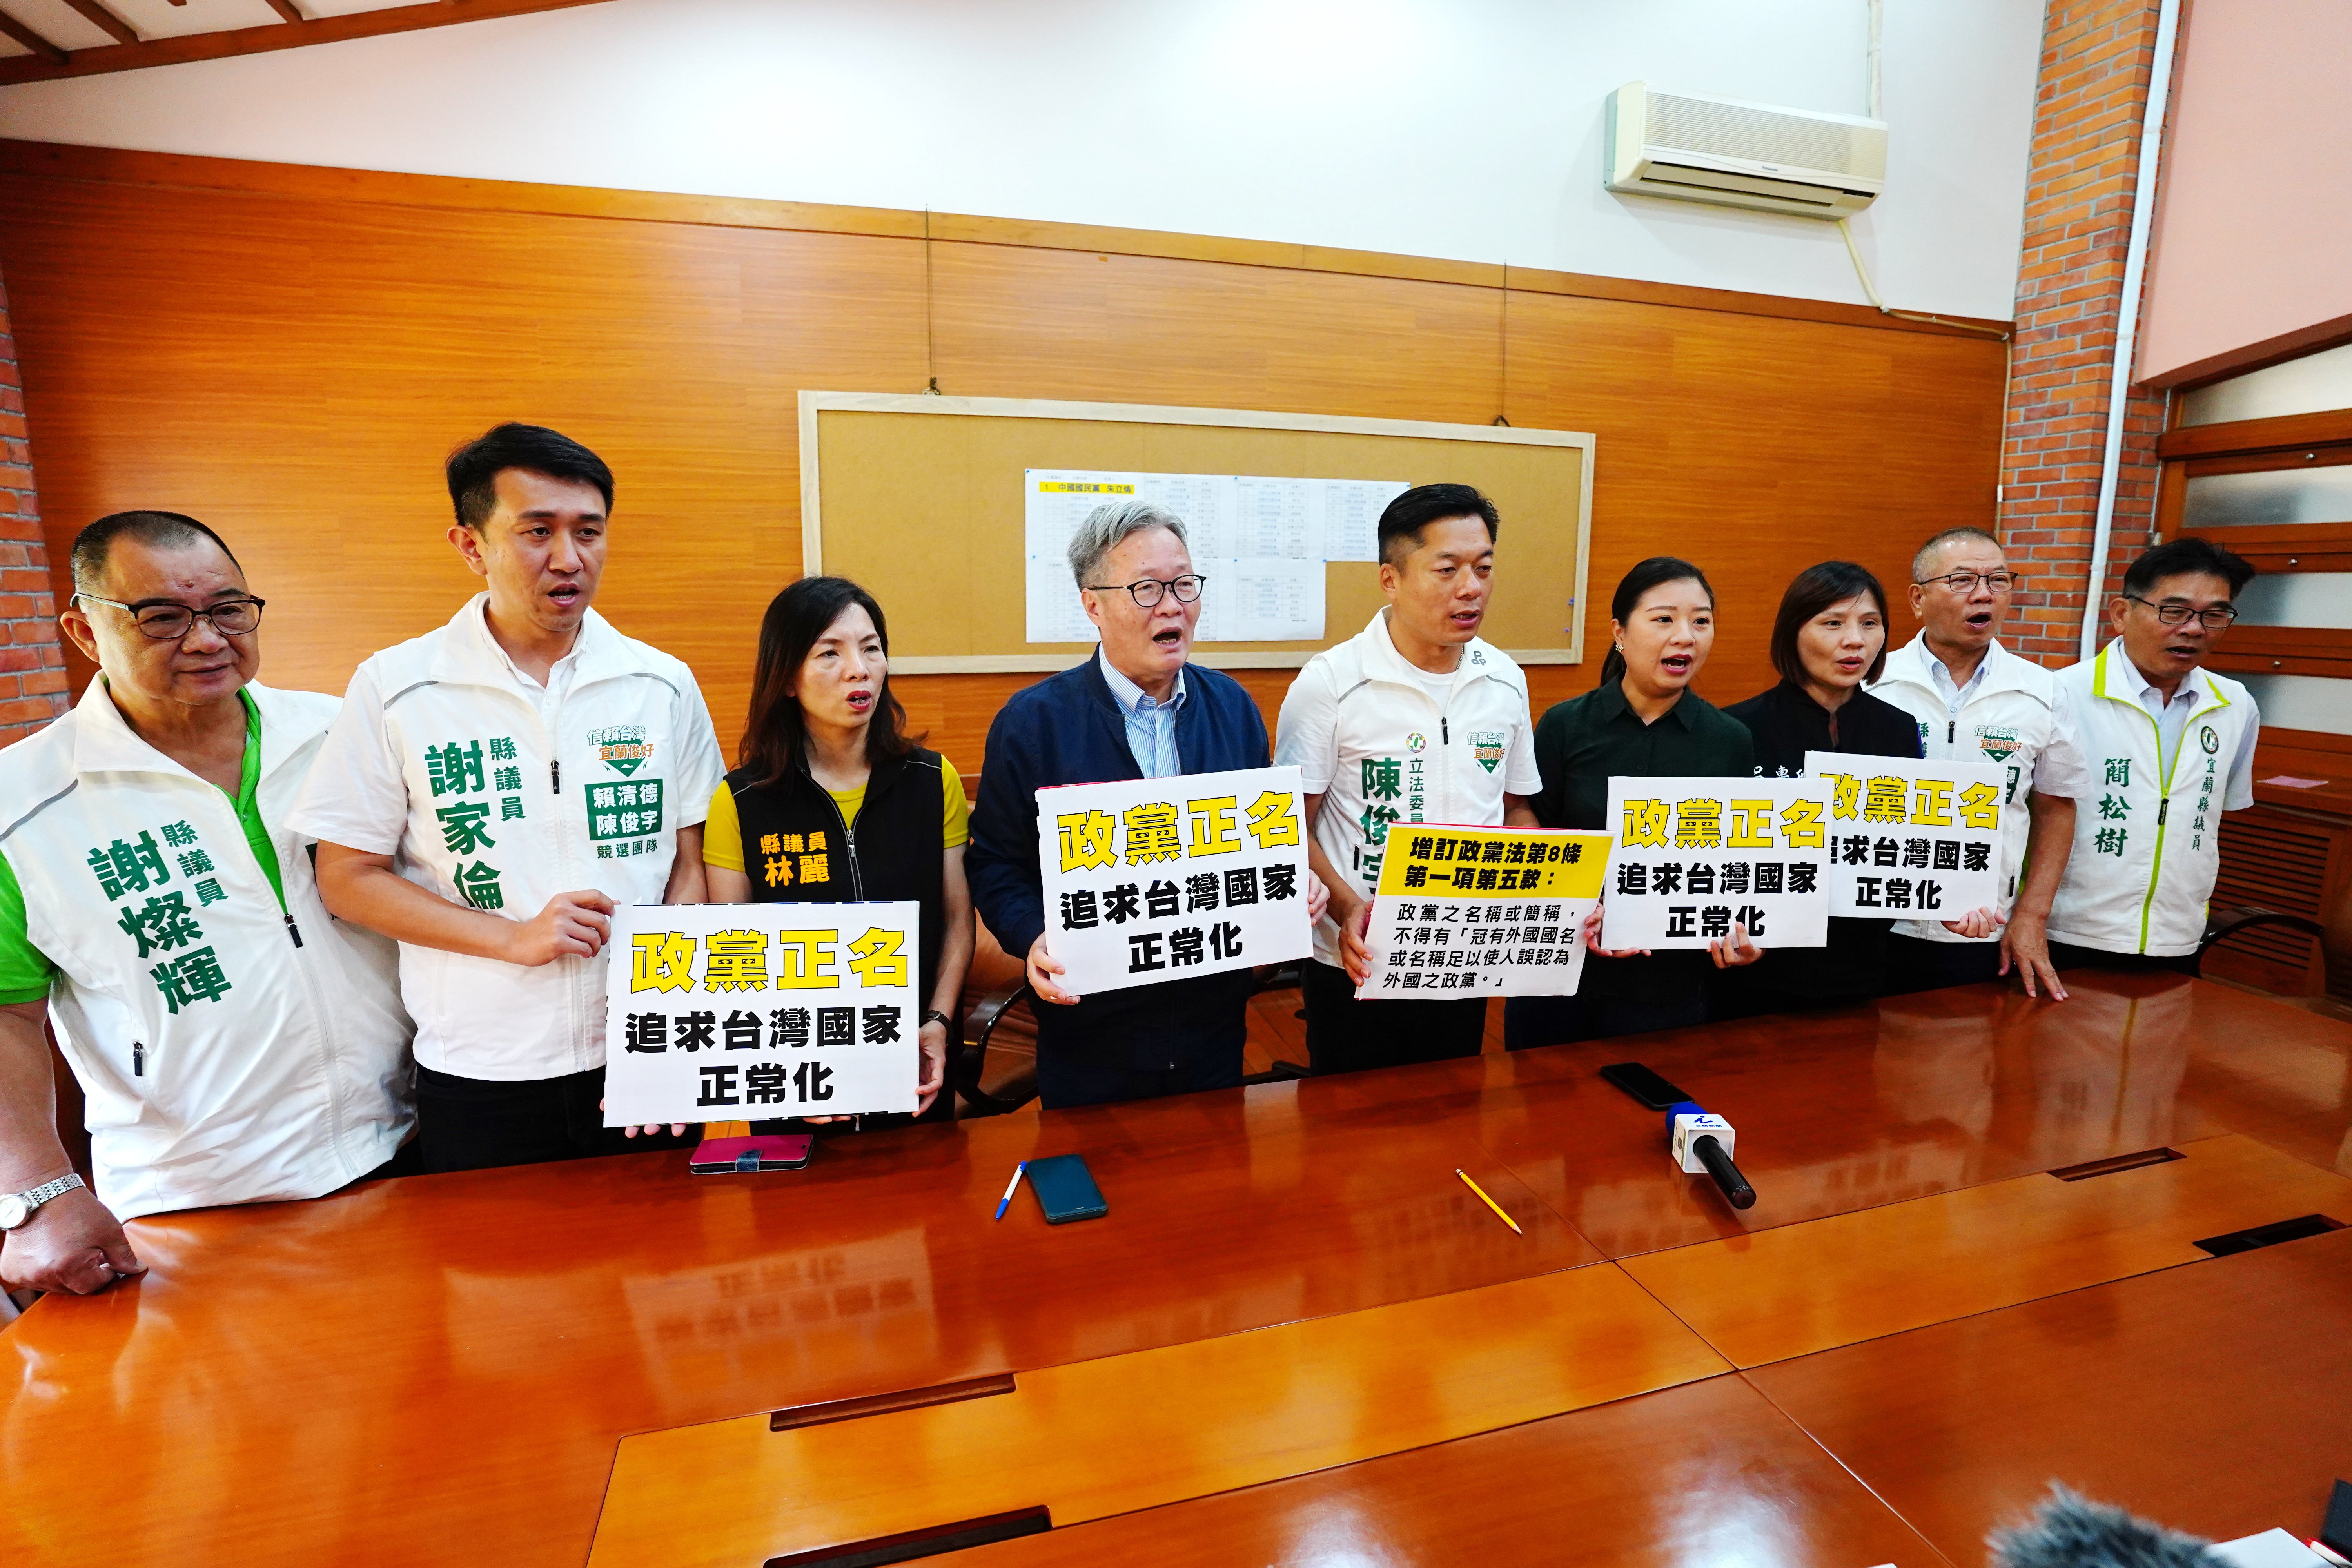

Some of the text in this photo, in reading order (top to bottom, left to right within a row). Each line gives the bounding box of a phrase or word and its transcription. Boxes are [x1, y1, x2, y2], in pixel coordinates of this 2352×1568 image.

[1059, 483, 1100, 492] 中國國民黨
[587, 725, 645, 746] 信賴台灣
[1466, 731, 1504, 745] 信賴台灣
[1974, 725, 2019, 739] 信賴台灣
[1980, 739, 2022, 751] 宜蘭俊好
[599, 744, 654, 760] 宜蘭俊好
[1474, 748, 1505, 759] 宜蘭俊好
[490, 737, 526, 822] 縣議員
[593, 783, 658, 809] 賴清德
[2093, 758, 2132, 857] 簡松樹
[2191, 757, 2216, 851] 宜蘭縣議員
[425, 740, 505, 909] 謝家倫
[596, 810, 658, 836] 陳俊宇
[1057, 791, 1299, 873] 政黨正名
[1622, 798, 1825, 849] 政黨正名
[597, 838, 657, 859] 競選團隊
[760, 831, 828, 855] 縣議員
[161, 820, 229, 907] 縣議員
[764, 854, 830, 887] 林麗
[1405, 865, 1555, 891] 第一項第五款：
[1617, 862, 1818, 895] 追求台灣國家
[1060, 864, 1298, 931] 追求台灣國家
[1855, 877, 1942, 910] 正常化
[87, 831, 232, 1015] 謝燦輝
[1666, 906, 1766, 937] 正常化
[631, 927, 908, 994] 政黨正名
[1129, 921, 1243, 974] 正常化
[1388, 948, 1569, 967] 或名稱足以使人誤認為
[625, 1005, 902, 1054] 追求台灣國家
[697, 1062, 834, 1107] 正常化
